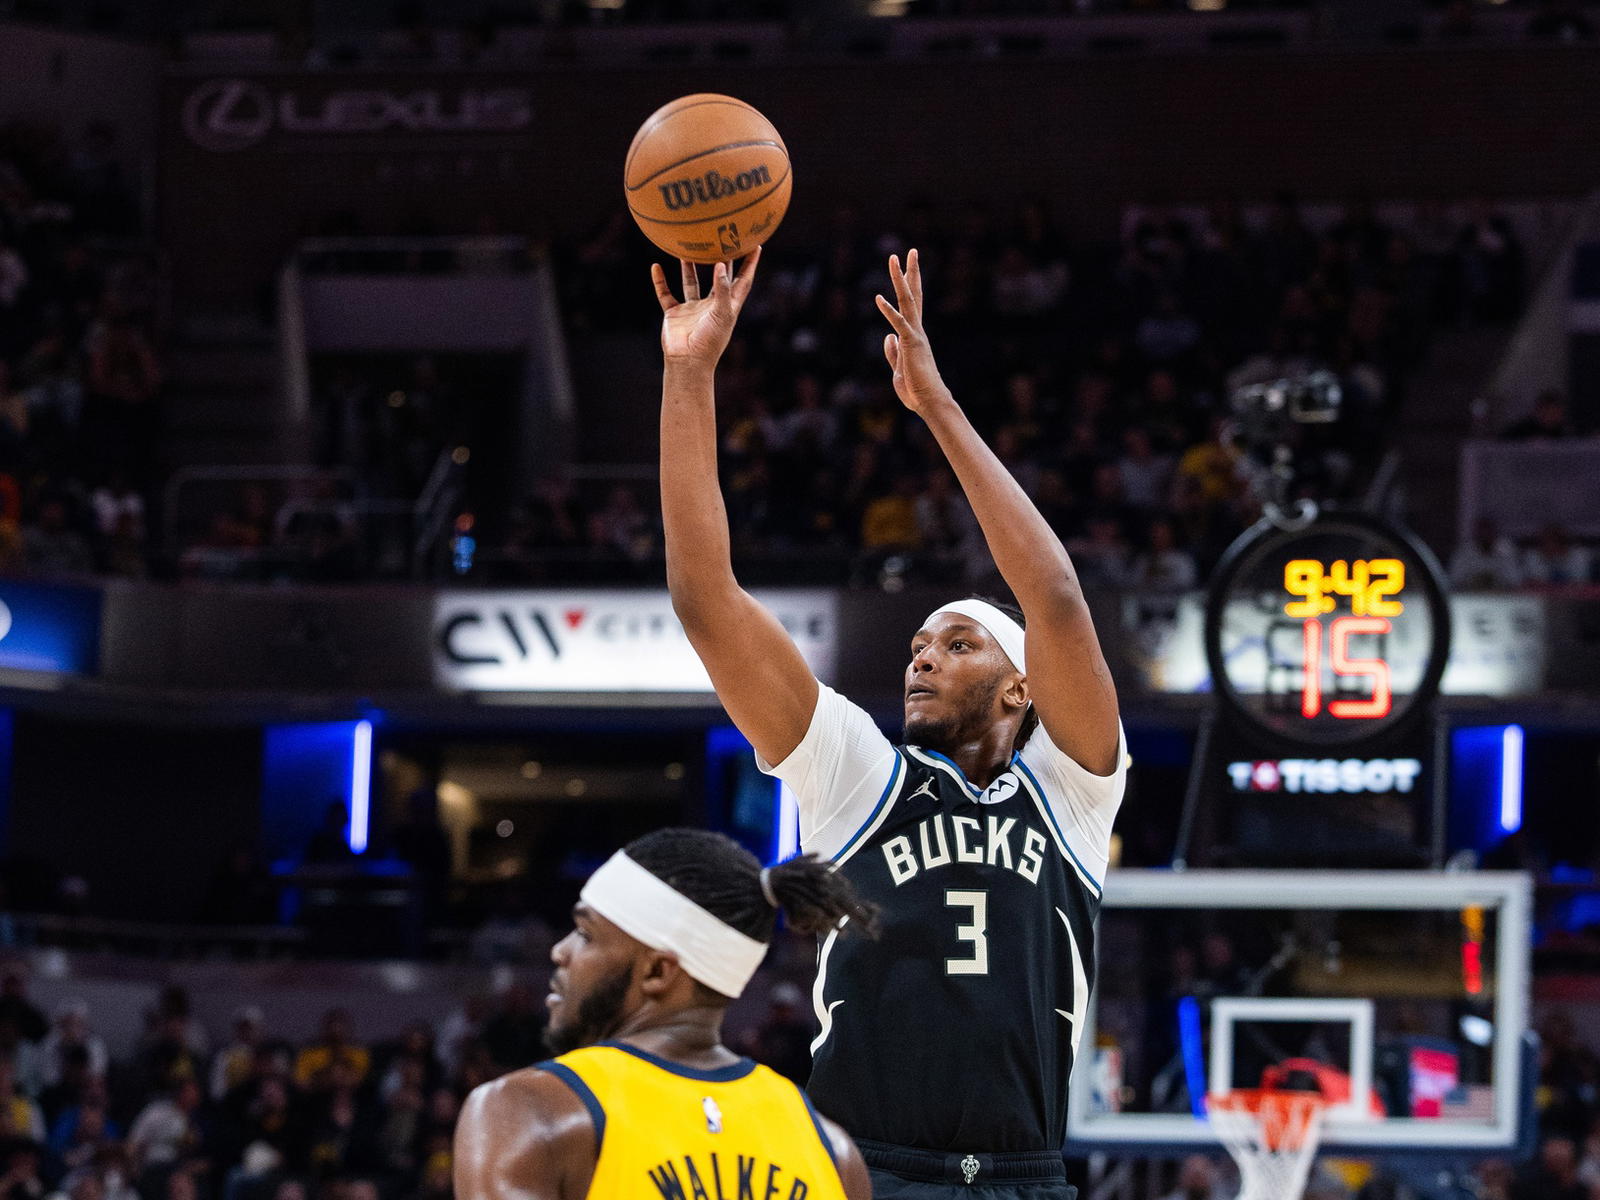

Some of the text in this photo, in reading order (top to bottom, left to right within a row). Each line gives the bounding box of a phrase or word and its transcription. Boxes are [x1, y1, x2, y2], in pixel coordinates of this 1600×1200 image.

[277, 88, 534, 131] LEXUS
[658, 165, 772, 211] Wilson
[1284, 559, 1405, 617] 9:42
[1302, 617, 1391, 718] 15
[1278, 758, 1421, 793] TISSOT
[881, 811, 1047, 886] BUCKS
[944, 889, 988, 976] 3
